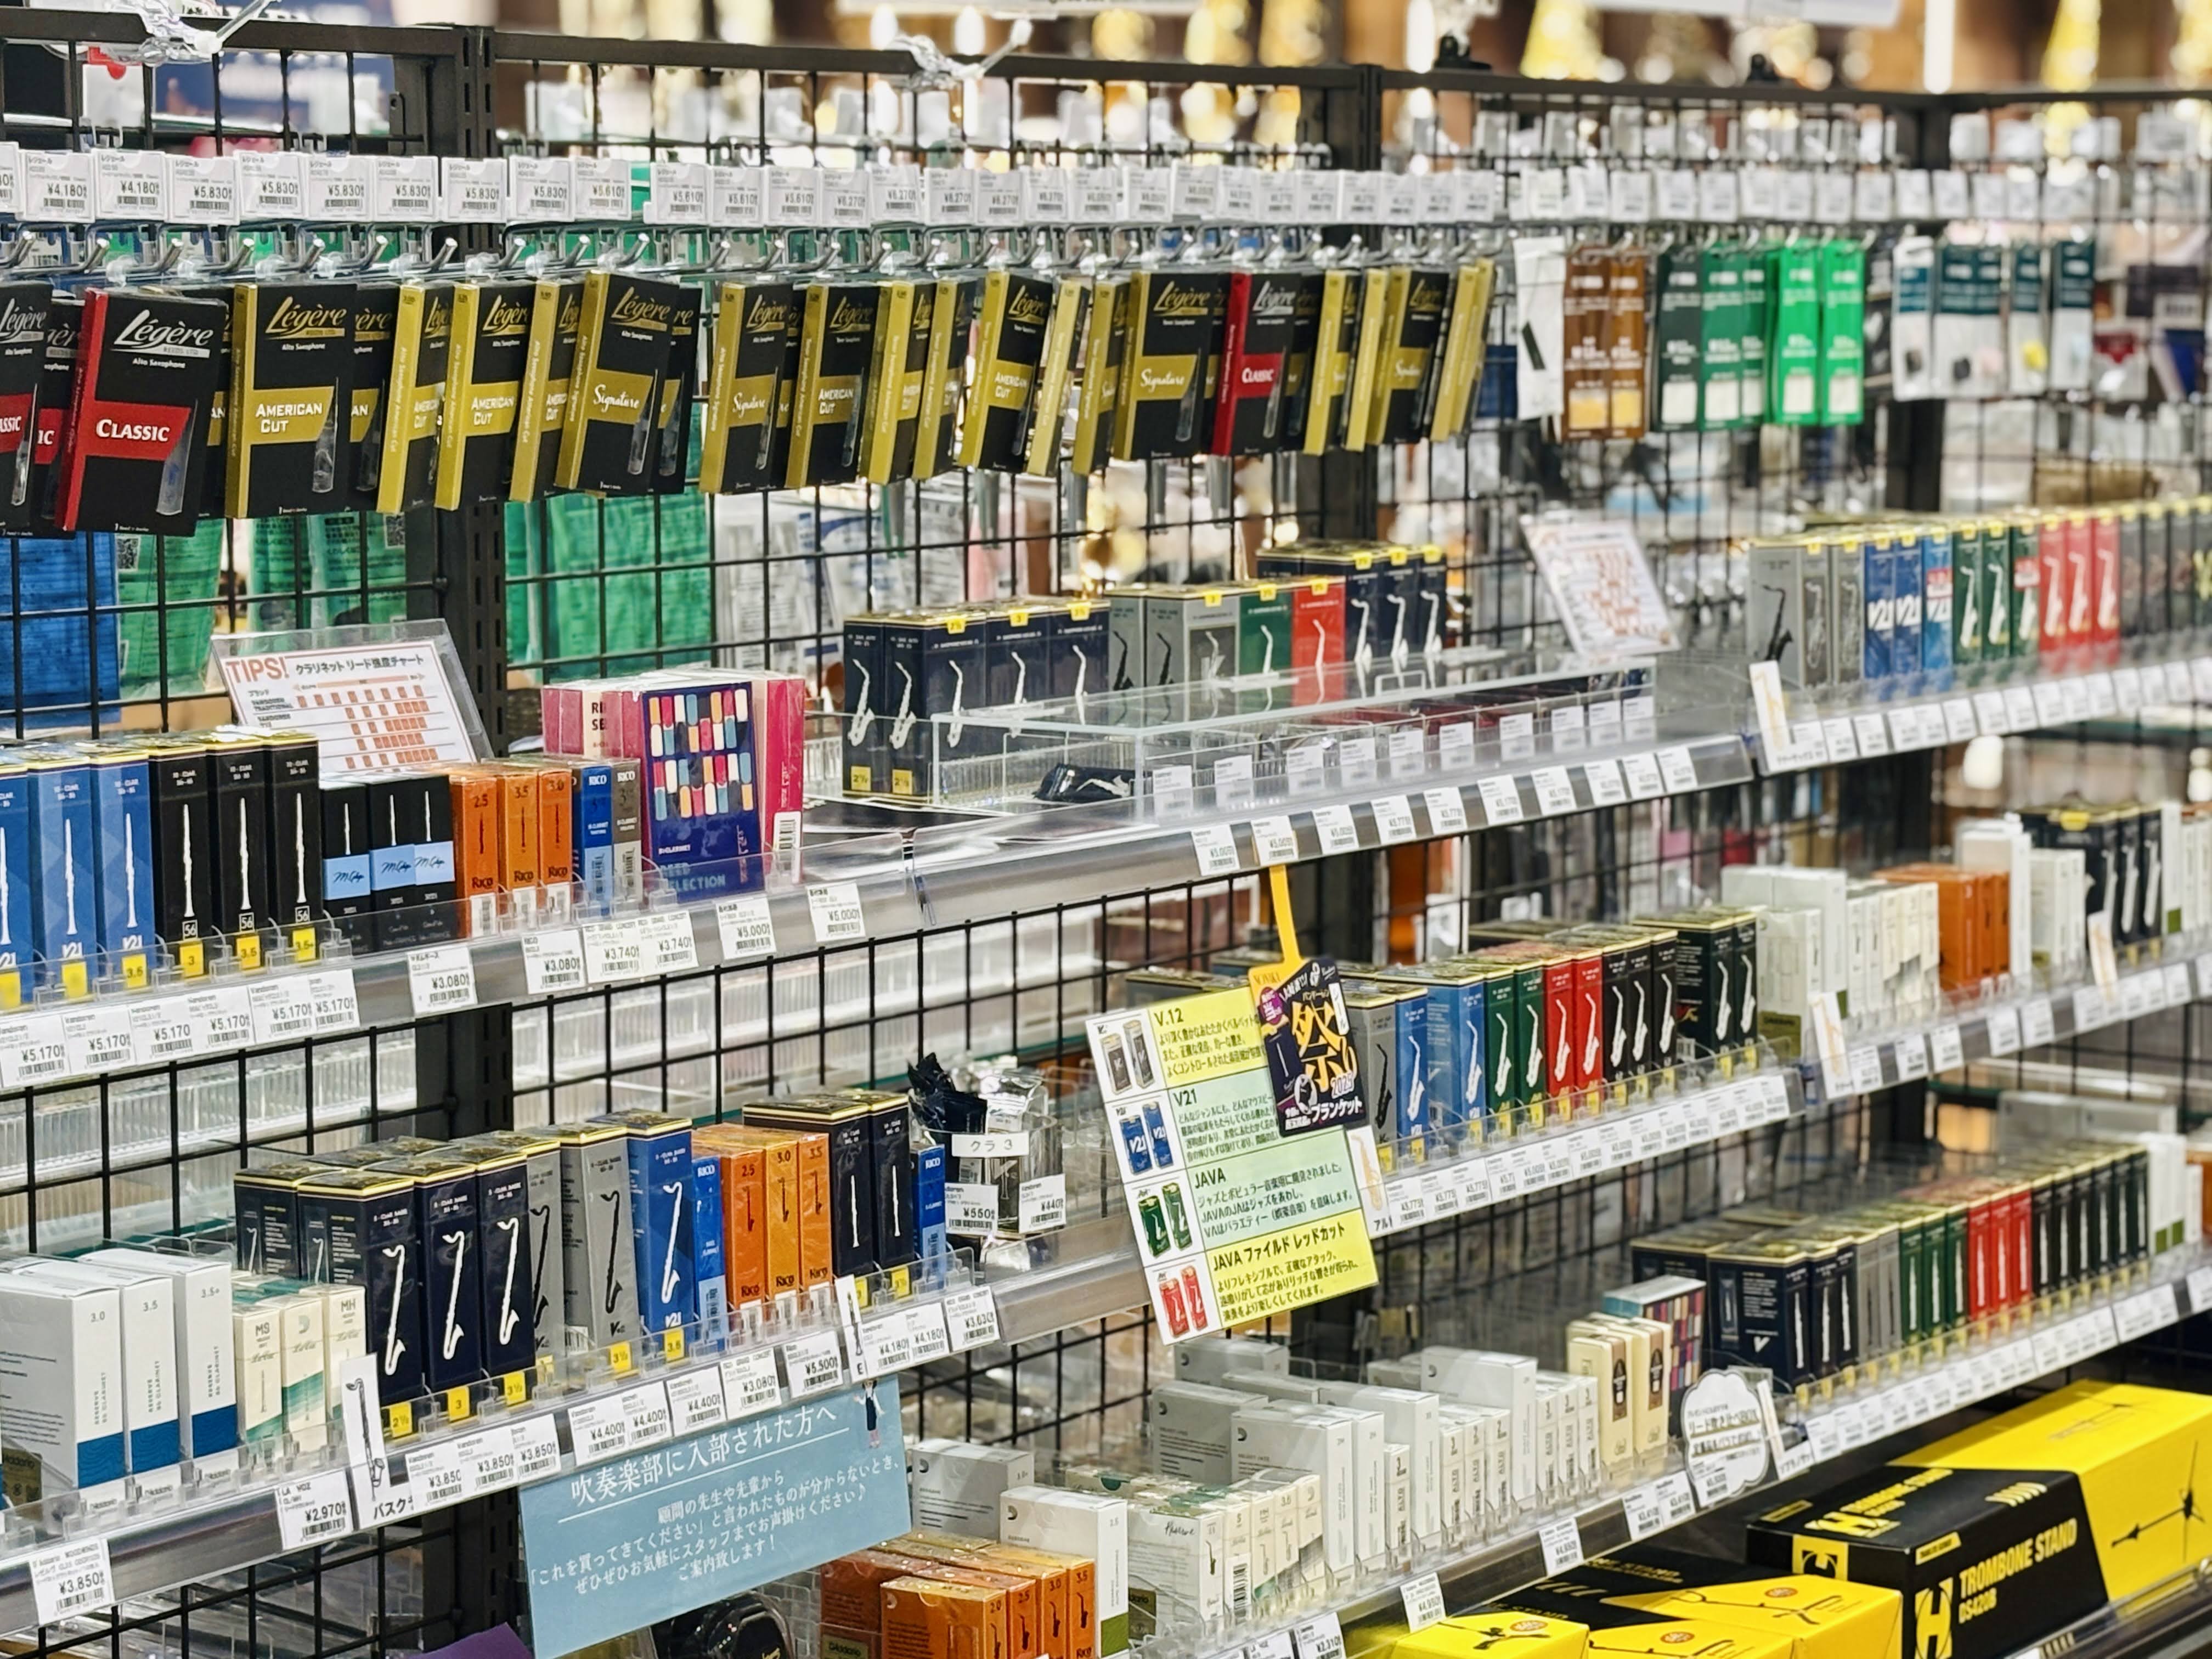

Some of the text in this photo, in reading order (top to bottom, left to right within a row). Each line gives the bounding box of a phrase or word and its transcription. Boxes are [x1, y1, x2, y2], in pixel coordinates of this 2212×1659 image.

[611, 286, 671, 325] Légère
[1153, 281, 1211, 315] Légère
[266, 296, 348, 336] Légère
[747, 294, 787, 329] Légère
[830, 296, 874, 329] Légère
[114, 309, 214, 346] Légère
[1140, 362, 1185, 392] Signature
[593, 384, 640, 413] Signature
[818, 388, 854, 401] AMERICAN
[255, 403, 323, 417] AMERICAN
[471, 396, 515, 411] AMERICAN
[819, 401, 836, 415] CUT
[260, 419, 289, 433] CUT
[473, 411, 492, 426] CUT
[95, 419, 171, 443] CLASSIC
[225, 656, 290, 684] TIPS!
[296, 661, 345, 675] クラリネット
[617, 771, 635, 781] RICO
[474, 794, 488, 808] 2.5
[670, 875, 725, 891] ELECTION
[240, 916, 254, 929] 56
[297, 909, 309, 922] 56
[184, 923, 196, 938] 56
[188, 955, 195, 966] 3
[1154, 1007, 1184, 1027] V.12
[1173, 1088, 1198, 1107] V21
[1311, 1096, 1363, 1124] ブランケット
[742, 1164, 755, 1176] 2.5
[1194, 1166, 1227, 1189] JAVA
[1213, 1250, 1244, 1272] JAVA
[143, 1300, 159, 1312] 3.5
[341, 1299, 356, 1313] MH
[91, 1311, 106, 1323] 3.0
[255, 1322, 270, 1337] MS
[455, 1399, 462, 1409] 3
[571, 1405, 837, 1507] 吹奏楽部に入部された方へ
[304, 1502, 342, 1522] ¥2,970
[1959, 1537, 2033, 1596] TROMBONE
[2034, 1517, 2078, 1562] STAND
[59, 1572, 100, 1594] ¥3,850
